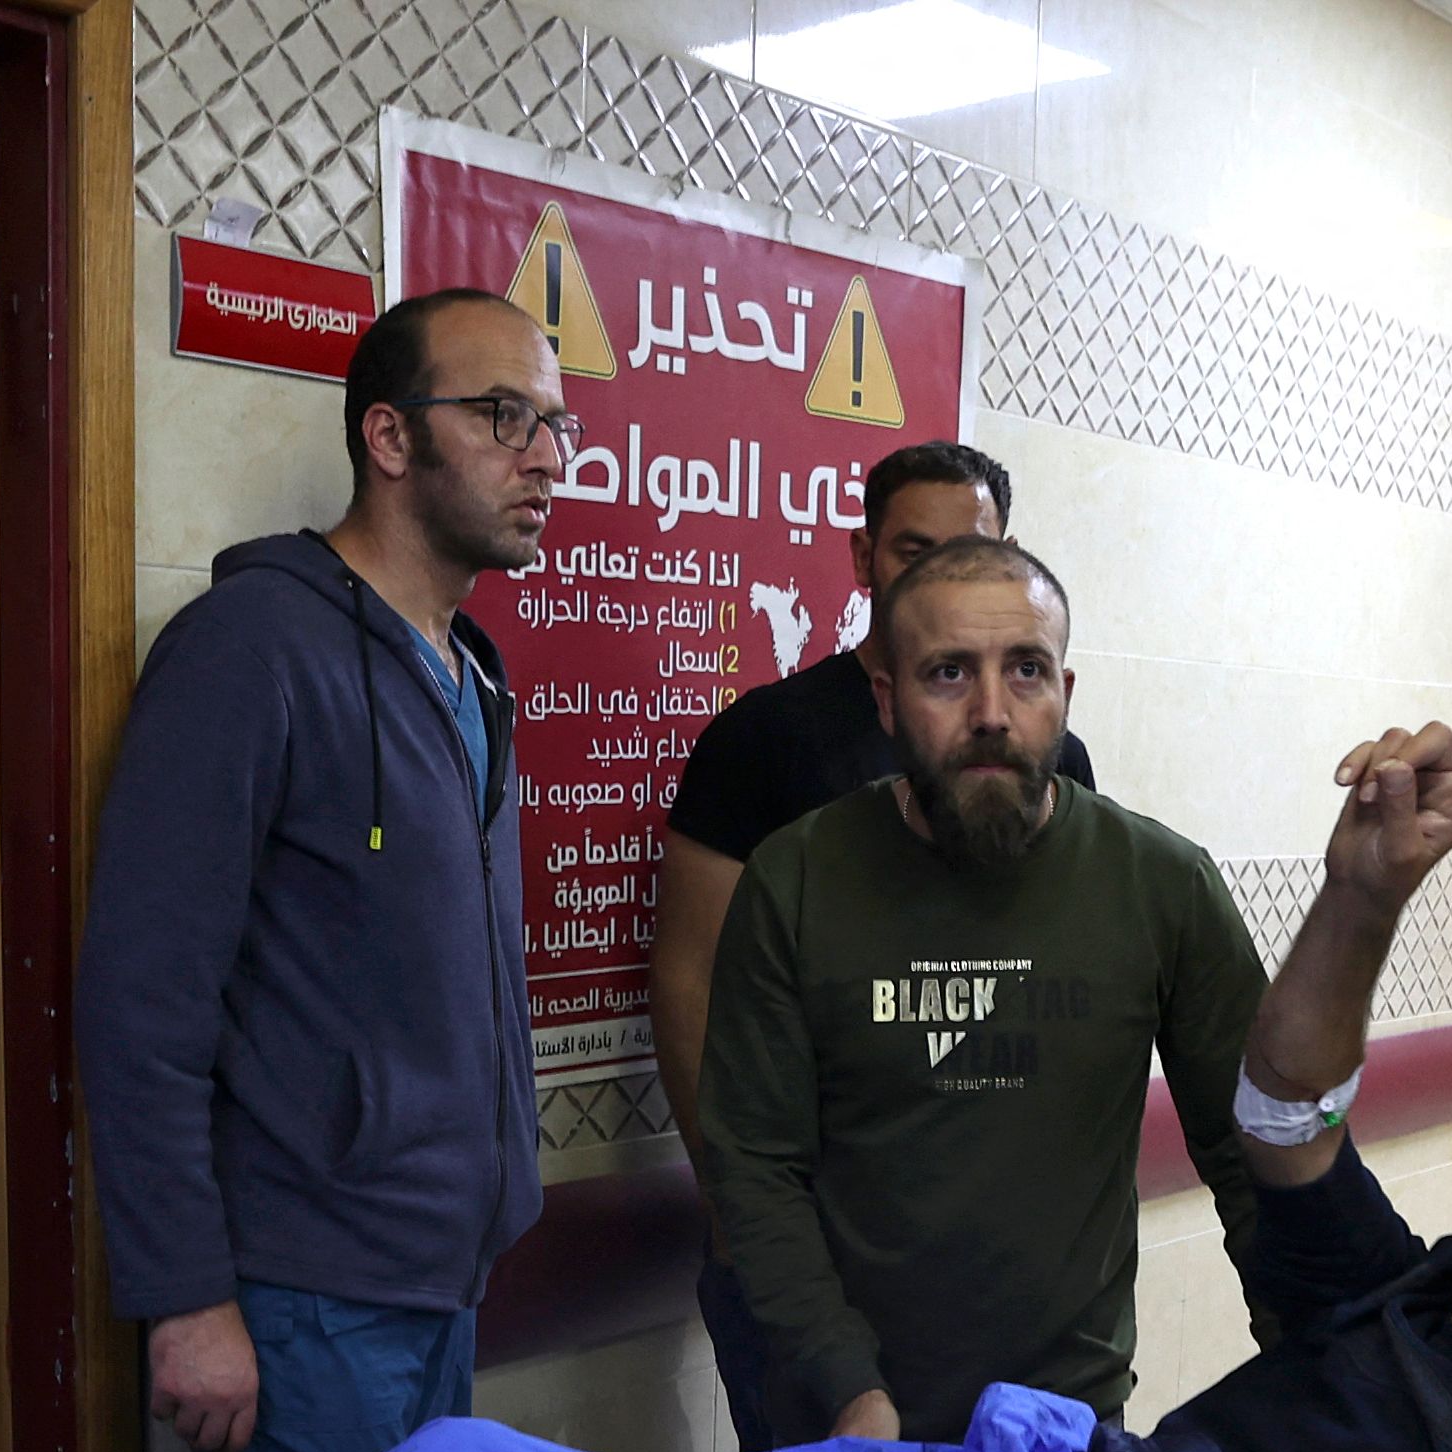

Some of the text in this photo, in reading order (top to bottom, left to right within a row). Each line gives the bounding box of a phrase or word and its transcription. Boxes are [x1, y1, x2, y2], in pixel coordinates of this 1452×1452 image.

[205, 282, 284, 325] الرئيسية
[628, 266, 813, 375] تحذير
[550, 423, 866, 545] خي المواط
[555, 541, 640, 585] تعاني
[644, 549, 702, 585] كنت
[708, 550, 739, 588] اذا
[517, 588, 589, 629] الحرارة
[596, 595, 649, 633] درجة
[655, 596, 713, 636] ارتفاع
[524, 681, 590, 721] الحلق
[597, 686, 638, 723] في
[586, 725, 649, 768] شديد
[547, 782, 624, 814] صعوبه
[631, 773, 651, 811] او
[547, 842, 579, 873] من
[910, 958, 1033, 972] ORIGINAL CLOTHING COMPANY
[871, 976, 998, 1023] BLACK
